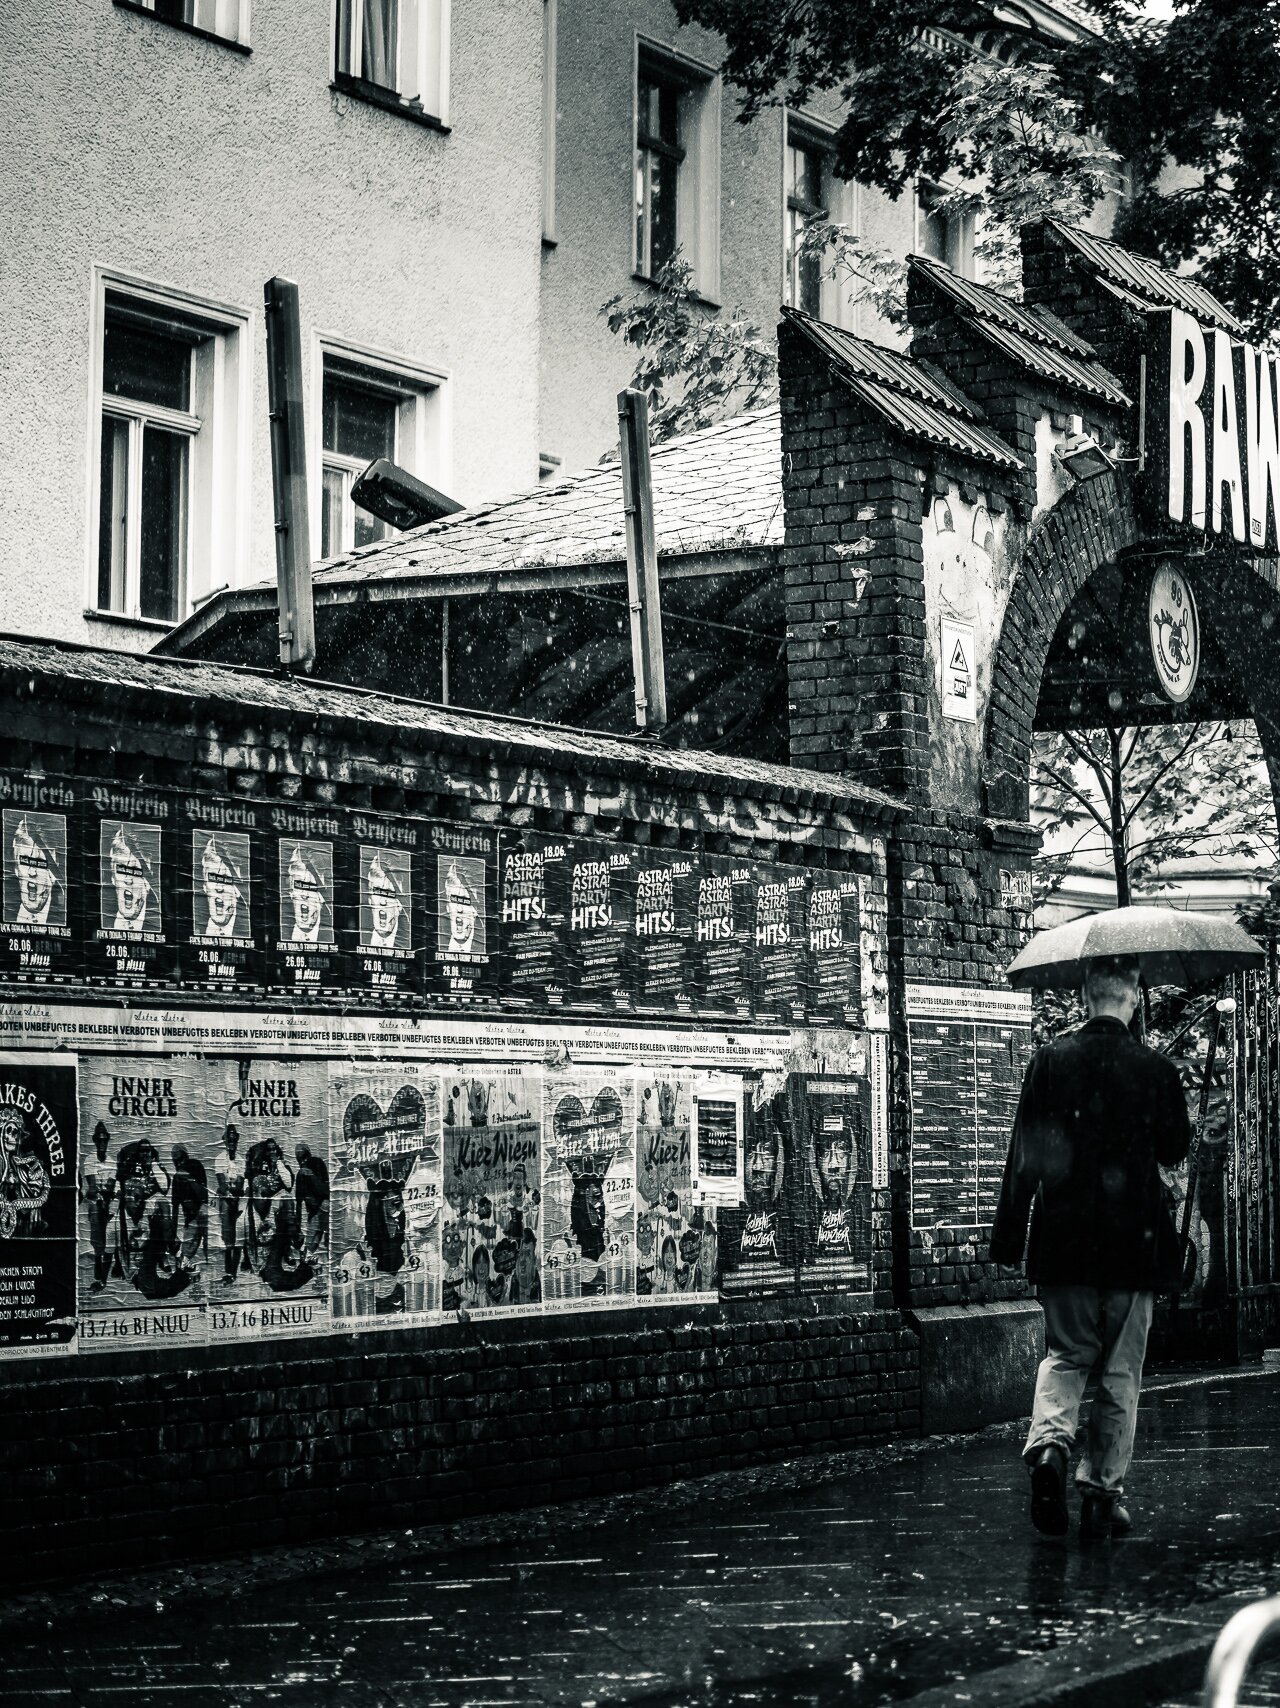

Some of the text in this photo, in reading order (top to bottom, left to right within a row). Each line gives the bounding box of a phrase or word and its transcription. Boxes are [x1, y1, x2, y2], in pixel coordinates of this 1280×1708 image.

[0, 776, 74, 808] Brujeria
[92, 787, 168, 818] Brujeria
[186, 798, 255, 828] Brujeria
[271, 808, 338, 838] Brujeria
[353, 817, 417, 846] Brujeria
[432, 827, 491, 854] Brujeria
[506, 846, 566, 868] ASTRA! 18.06.
[573, 854, 630, 877] ASTRA! 18.06.
[505, 866, 544, 881] ASTRA!
[638, 862, 692, 883] ASTRA! 18.06.
[700, 869, 750, 891] ASTRA! 18.06.
[503, 881, 544, 898] PARTY!
[573, 875, 610, 890] ASTRA!
[637, 882, 673, 898] ASTRA!
[758, 876, 806, 897] ASTRA! 18.06.
[572, 889, 610, 906] PARTY!
[636, 896, 673, 912] PARTY!
[699, 889, 732, 904] ASTRA!
[758, 895, 788, 910] ASTRA!
[811, 889, 840, 903] ASTRA!
[503, 897, 545, 922] HITS!
[571, 904, 612, 930] HITS!
[698, 902, 733, 918] PARTY!
[810, 901, 841, 916] ASTRA!
[636, 911, 675, 936] HITS!
[698, 917, 733, 942] HITS!
[756, 923, 790, 947] HITS!
[810, 928, 842, 951] HITS!
[9, 938, 33, 952] 26.06.
[106, 945, 130, 958] 26.06.
[198, 951, 220, 962] 26.06.
[285, 956, 307, 968] 26.06.
[364, 960, 383, 972] 26.06.
[443, 966, 460, 976] 26.06.
[25, 1022, 76, 1032] UNBEFUGTES
[79, 1024, 118, 1034] BEKLEBEN
[120, 1026, 160, 1036] VERBOTEN
[162, 1027, 209, 1037] UNBEFUGTES
[212, 1029, 248, 1038] BEKLEBEN
[251, 1030, 286, 1039] VERBOTEN
[287, 1031, 330, 1040] UNBEFUGTES
[332, 1032, 365, 1041] BEKLEBEN
[368, 1033, 400, 1042] VERBOTEN
[402, 1034, 441, 1043] UNBEFUGTES
[443, 1036, 474, 1044] BEKLEBEN
[475, 1037, 505, 1045] VERBOTEN
[507, 1038, 544, 1047] UNBEFUGTES
[575, 1040, 604, 1048] VERBOTEN
[604, 1042, 638, 1050] UNBEFUGTES
[640, 1043, 665, 1051] BEKLEBEN
[693, 1045, 724, 1053] UNBEFUGTES
[112, 1077, 174, 1097] INNER
[245, 1080, 298, 1098] NNER
[109, 1097, 177, 1116] CIRCLE
[238, 1099, 300, 1116] CIRCLE
[36, 1103, 64, 1176] THREE
[650, 1133, 678, 1166] Kiez
[408, 1185, 438, 1200] 22.-25.
[607, 1178, 633, 1193] 22.-25.
[22, 1266, 43, 1276] STROM
[16, 1281, 35, 1290] LUXOR
[80, 1314, 189, 1338] 13.7.16 BI NUU
[212, 1306, 312, 1329] 13.7.16 BI NUU
